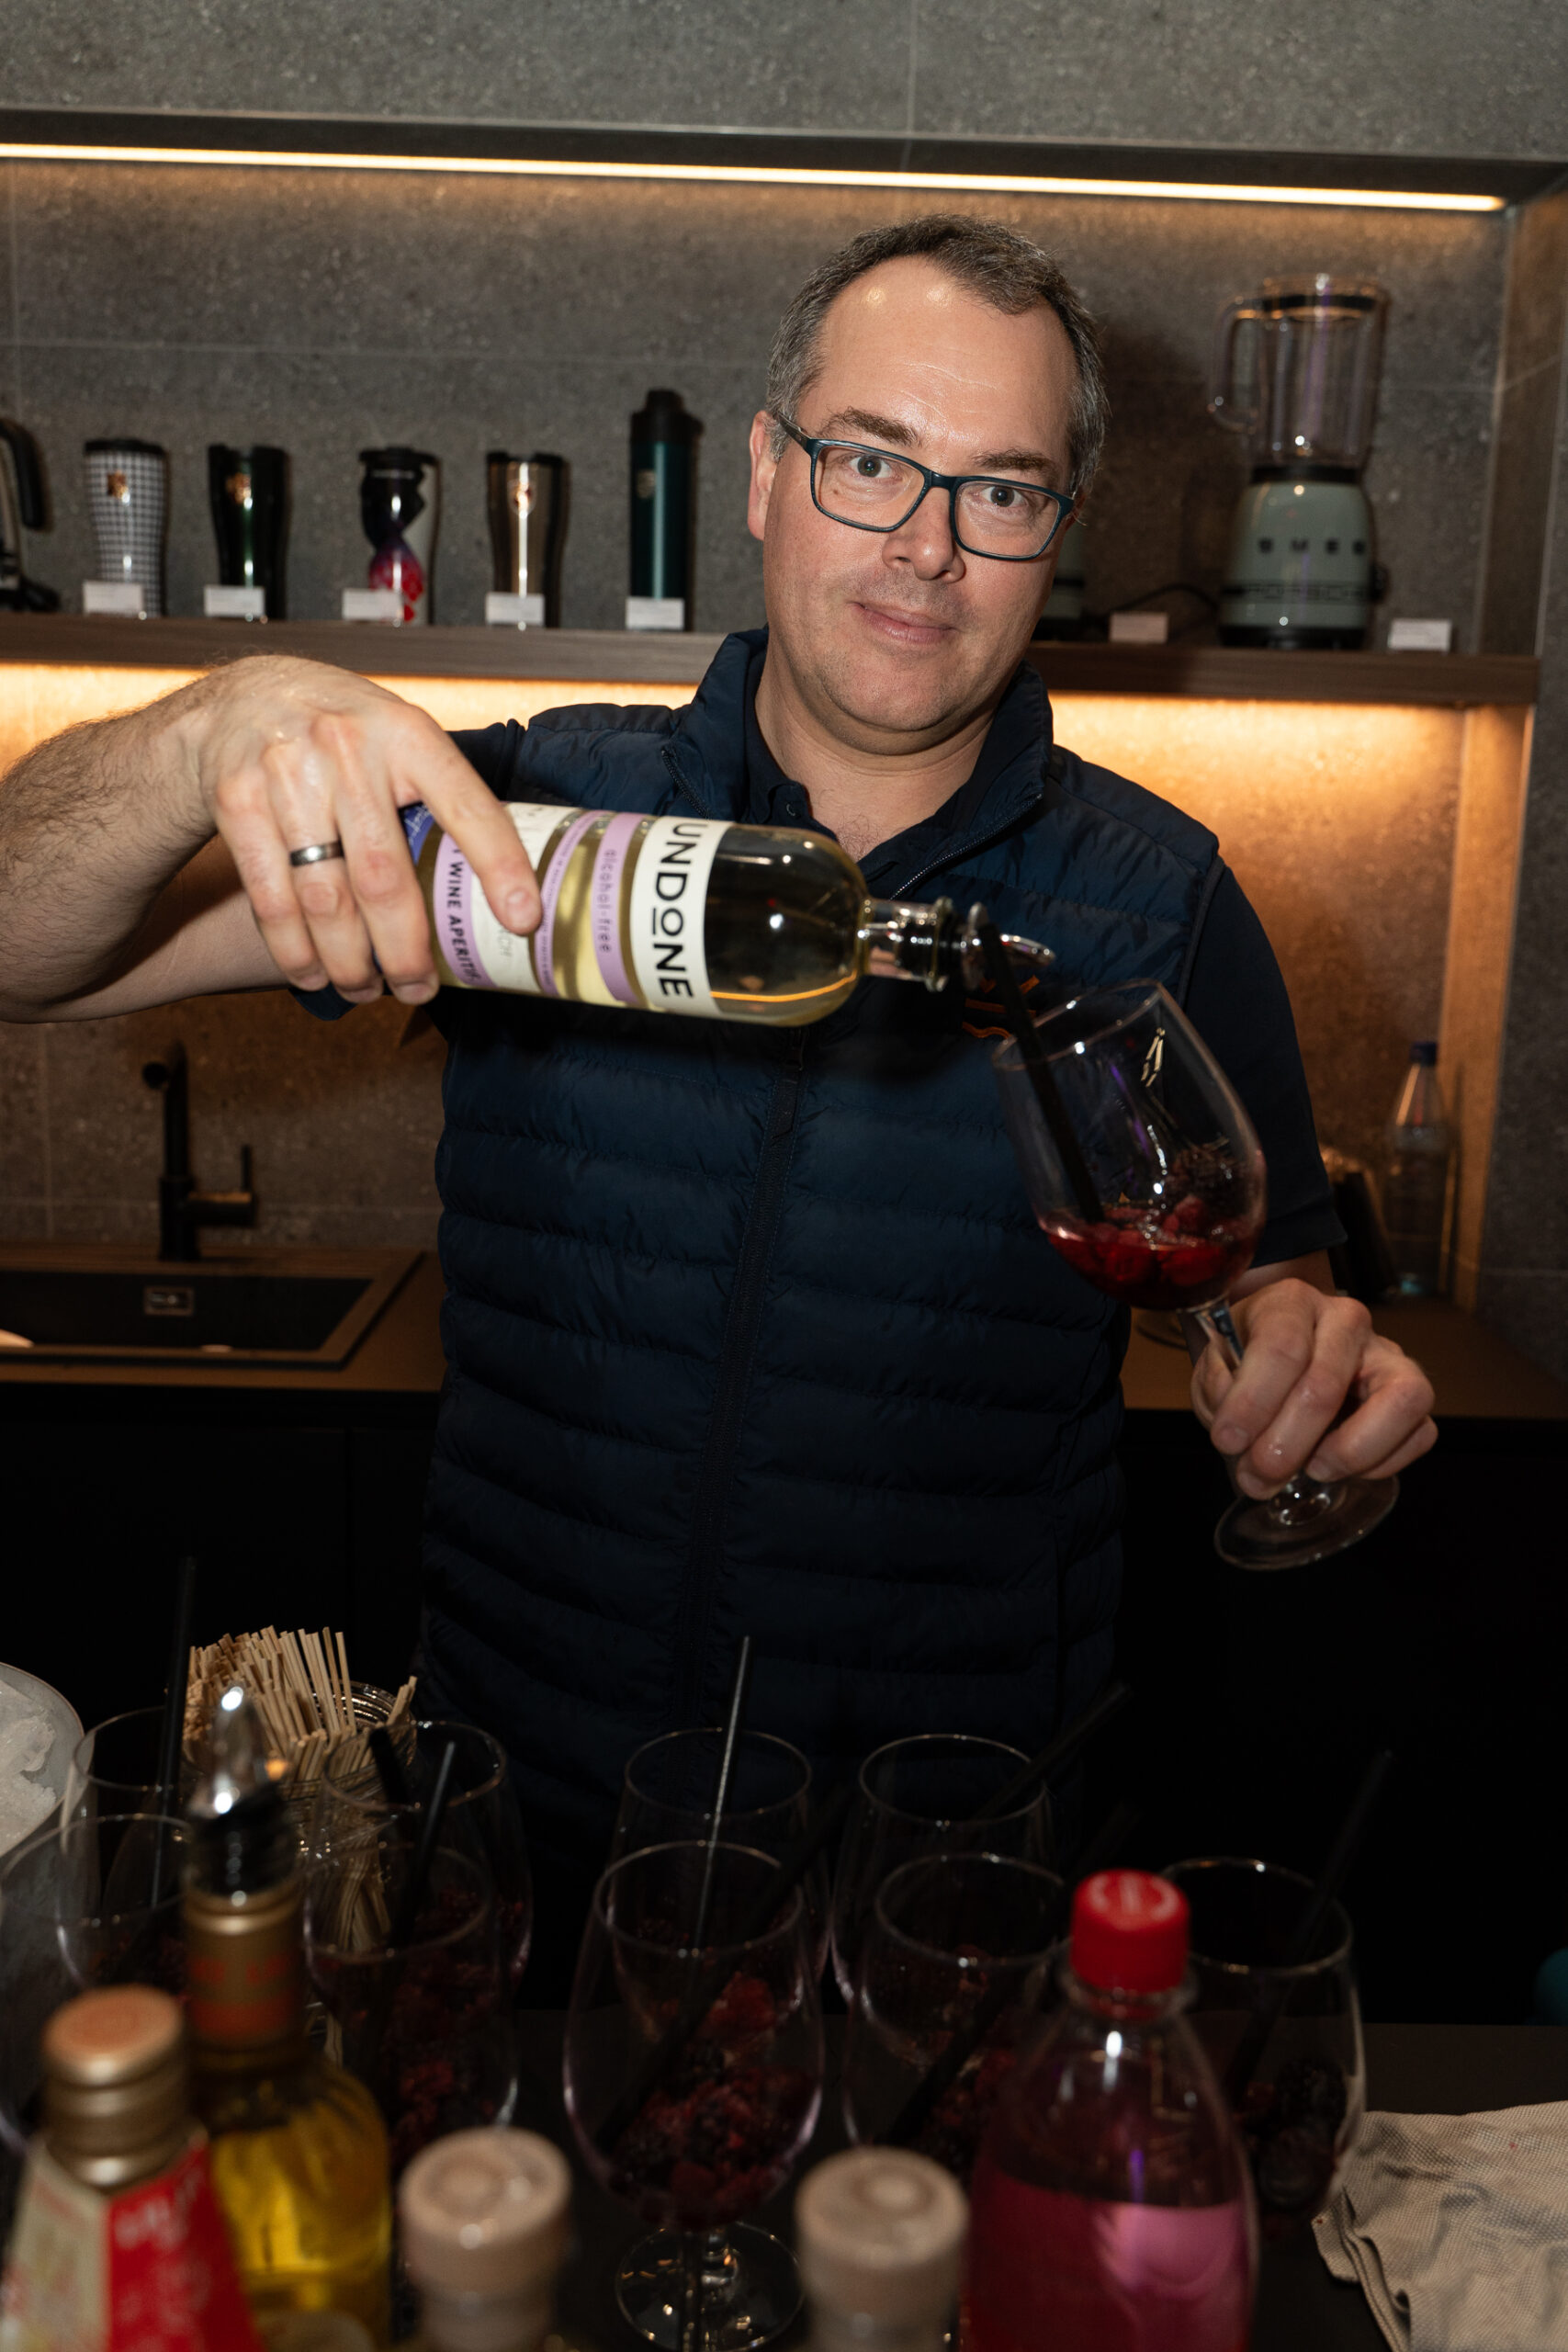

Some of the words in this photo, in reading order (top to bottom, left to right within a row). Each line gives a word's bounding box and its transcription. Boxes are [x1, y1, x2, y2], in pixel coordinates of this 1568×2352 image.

[446, 861, 465, 909] WINE
[597, 849, 618, 954] alcohol-free
[652, 822, 709, 998] UNDONE
